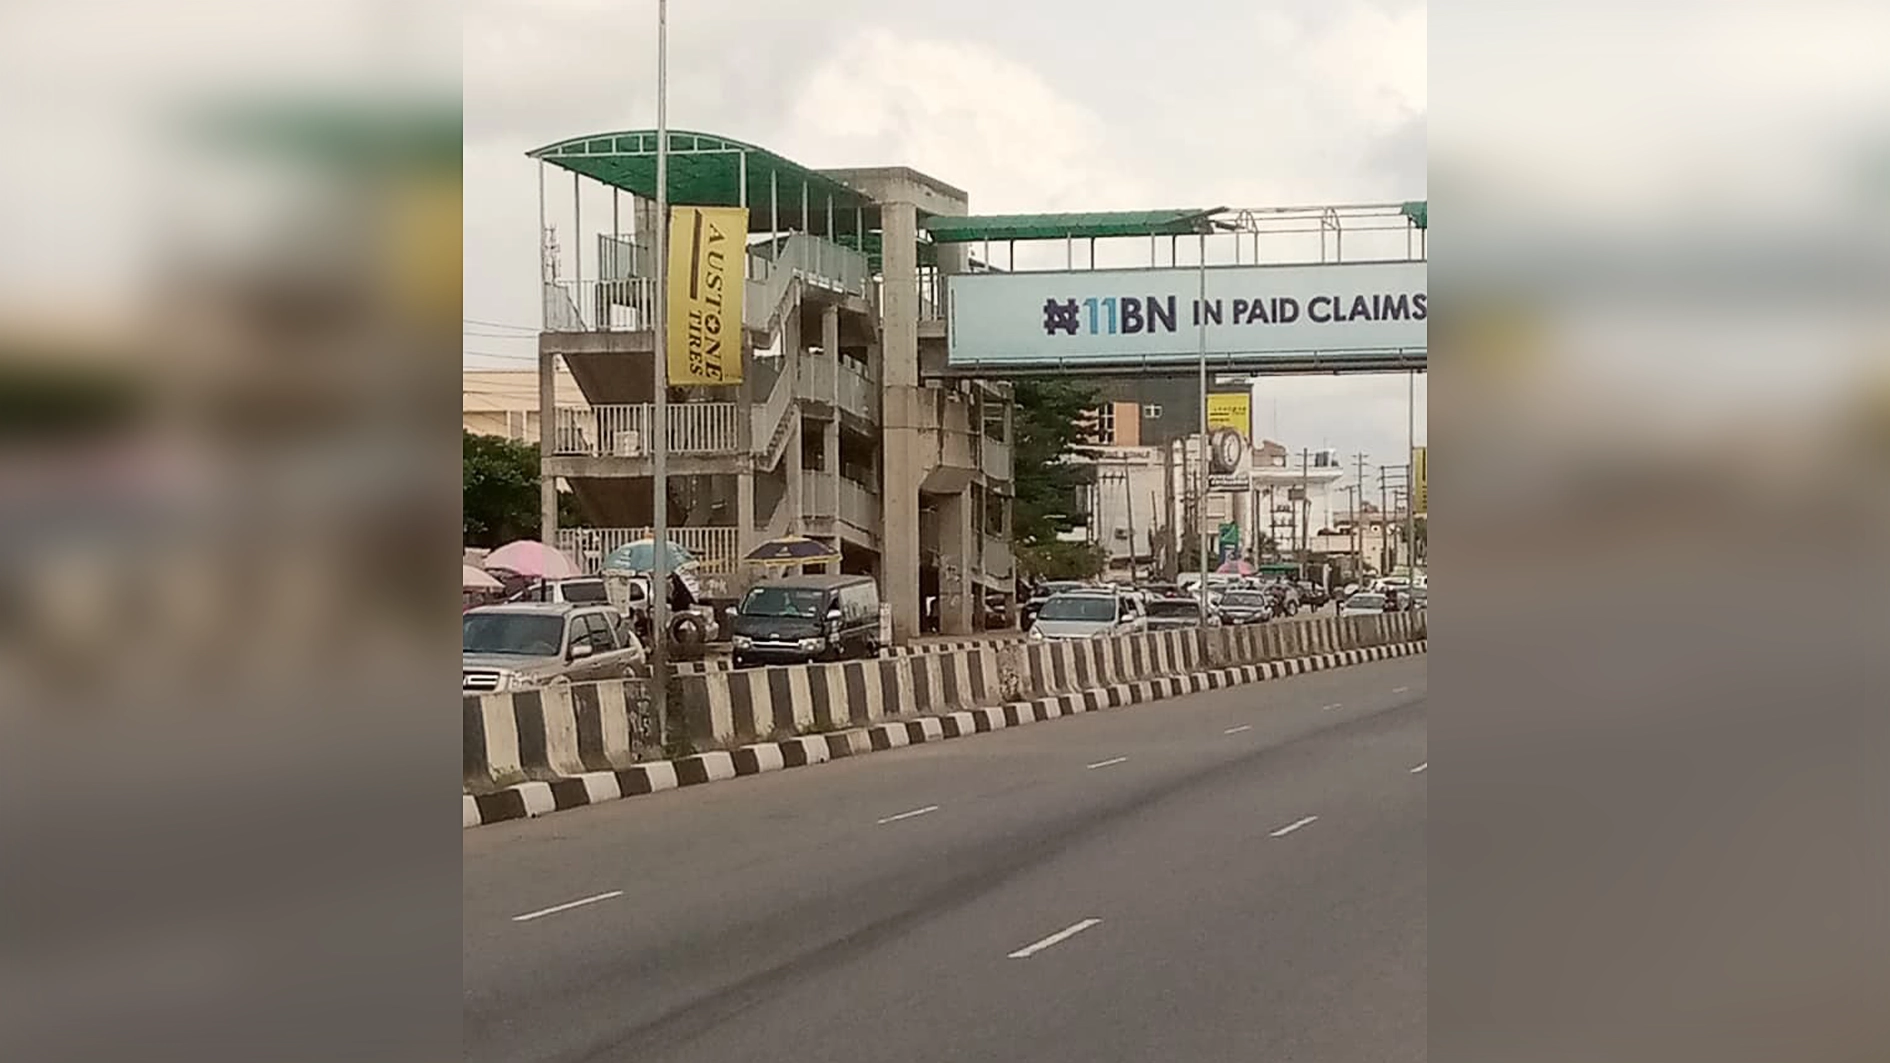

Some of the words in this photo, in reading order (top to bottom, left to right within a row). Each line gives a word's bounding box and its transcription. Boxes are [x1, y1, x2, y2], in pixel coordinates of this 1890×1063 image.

[704, 223, 726, 381] AUSTONE
[1192, 299, 1223, 325] IN
[1233, 298, 1299, 325] PAID
[1307, 293, 1427, 323] CLAIMS
[689, 310, 703, 376] TIRES
